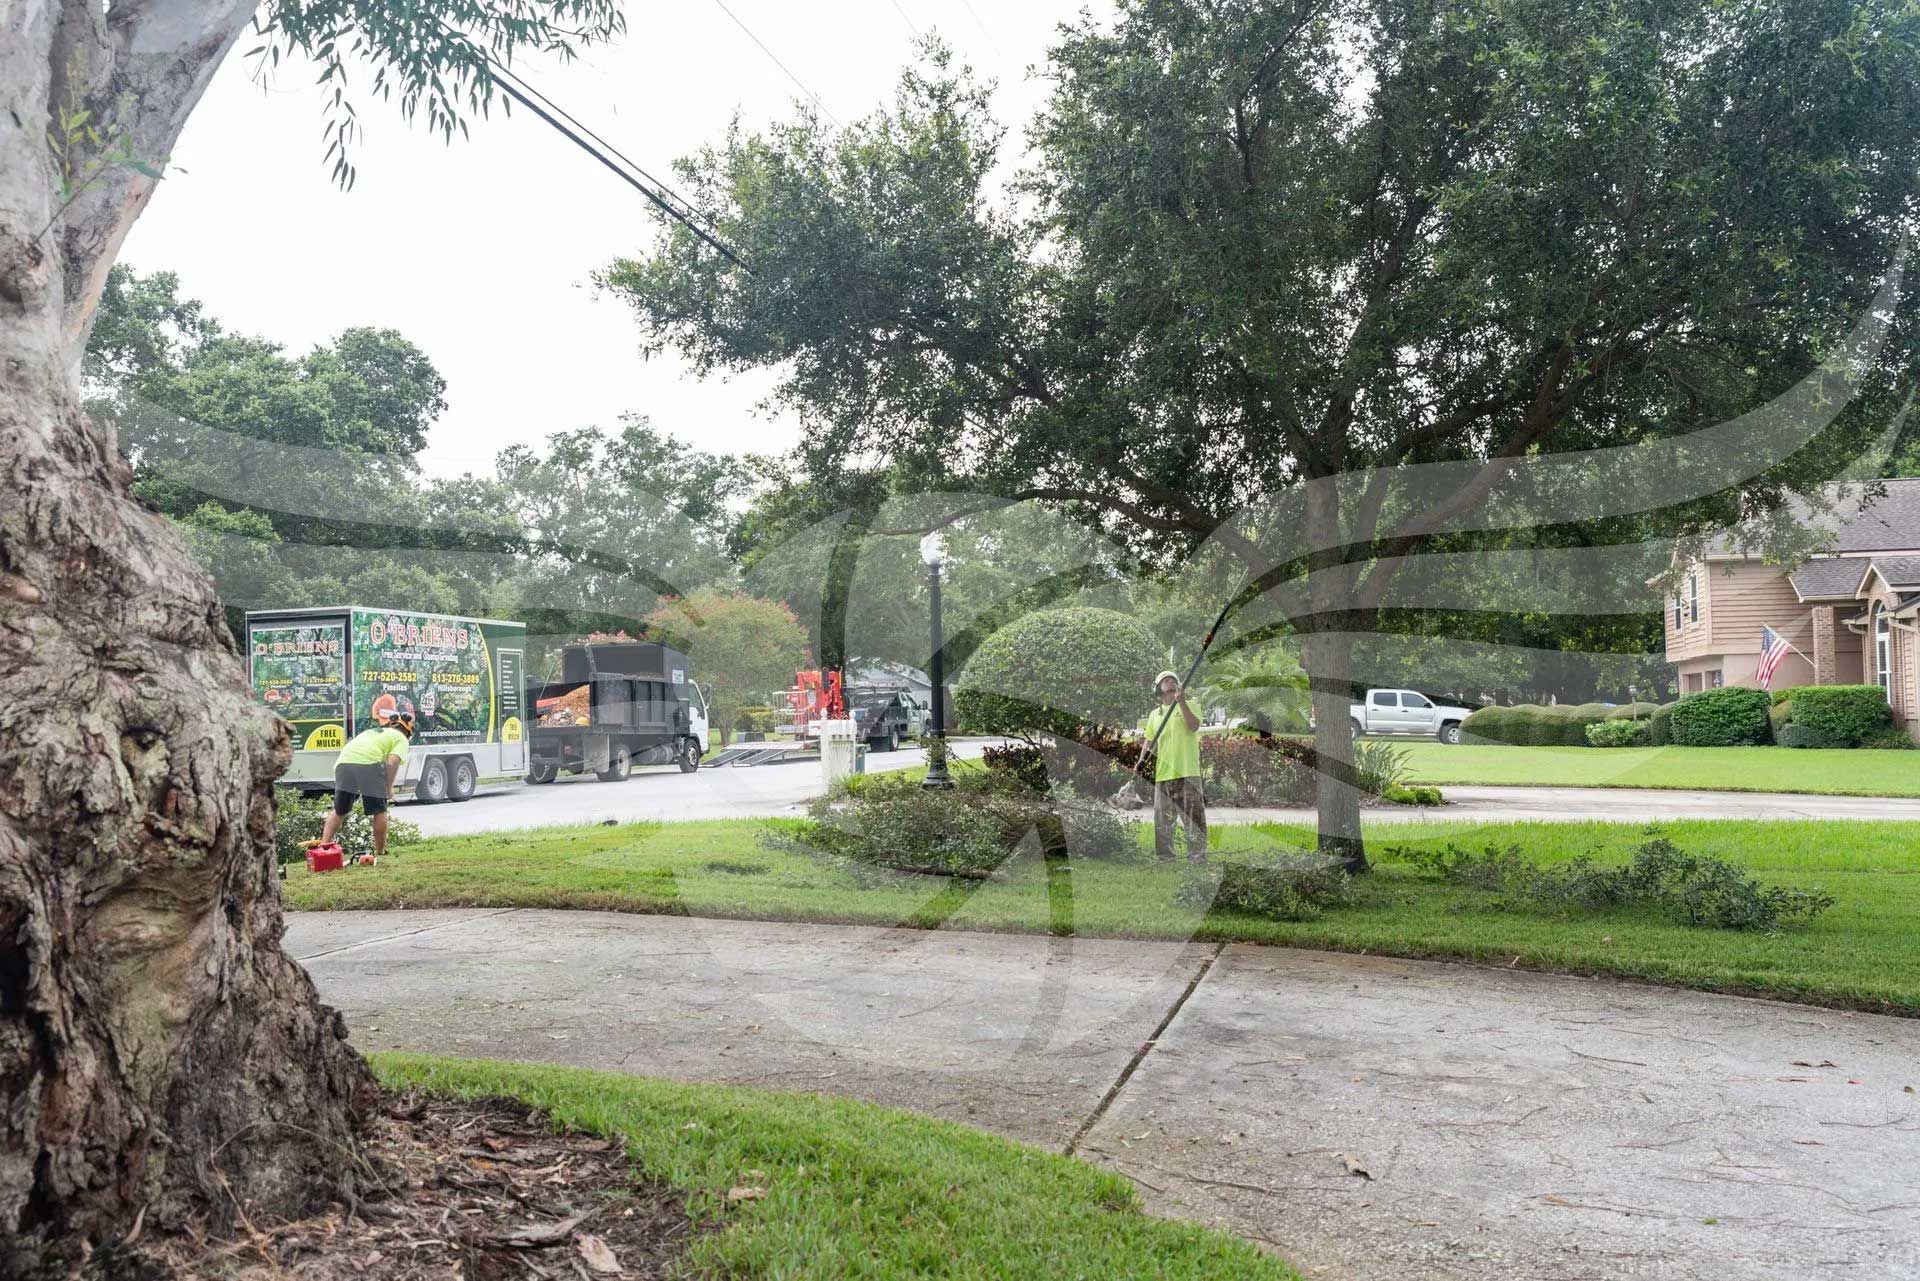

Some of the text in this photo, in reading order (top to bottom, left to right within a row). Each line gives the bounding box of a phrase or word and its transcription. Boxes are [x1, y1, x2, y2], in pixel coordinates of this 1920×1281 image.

[371, 621, 469, 649] O'BRIENS
[255, 640, 339, 656] O'BRIENS
[363, 671, 417, 682] 727-520-2582
[438, 684, 472, 693] Hillsborough
[320, 729, 337, 738] FREE
[316, 739, 341, 748] MULCH
